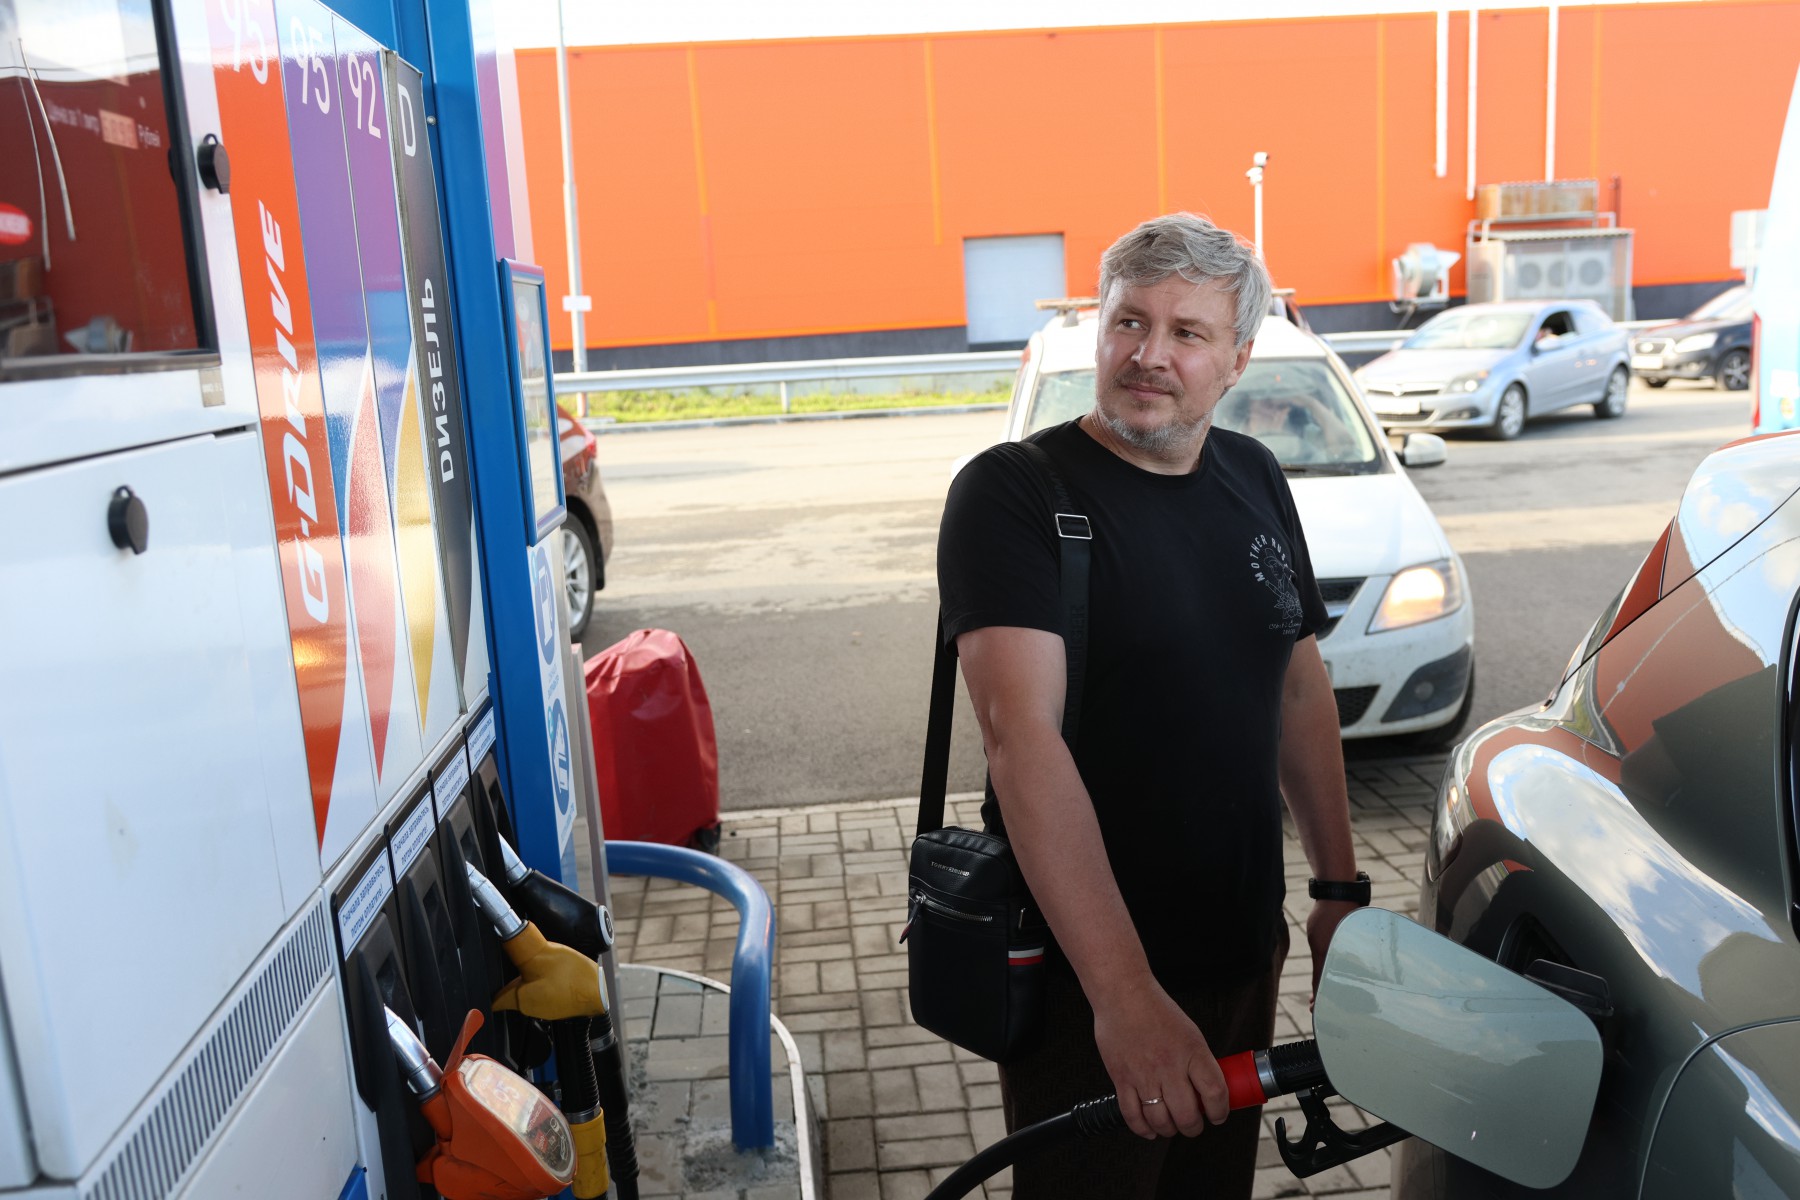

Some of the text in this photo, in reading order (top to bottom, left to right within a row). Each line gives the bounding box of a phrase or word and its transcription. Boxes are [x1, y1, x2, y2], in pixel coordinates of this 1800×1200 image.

[219, 0, 268, 85] 95
[290, 15, 330, 114] 95
[347, 53, 381, 139] 92
[397, 83, 417, 157] D
[258, 199, 329, 624] G-DRIVE
[1249, 534, 1268, 582] MOTHER
[342, 863, 385, 927] Сначала заправьтесь,
[350, 881, 383, 938] потом оплатите!
